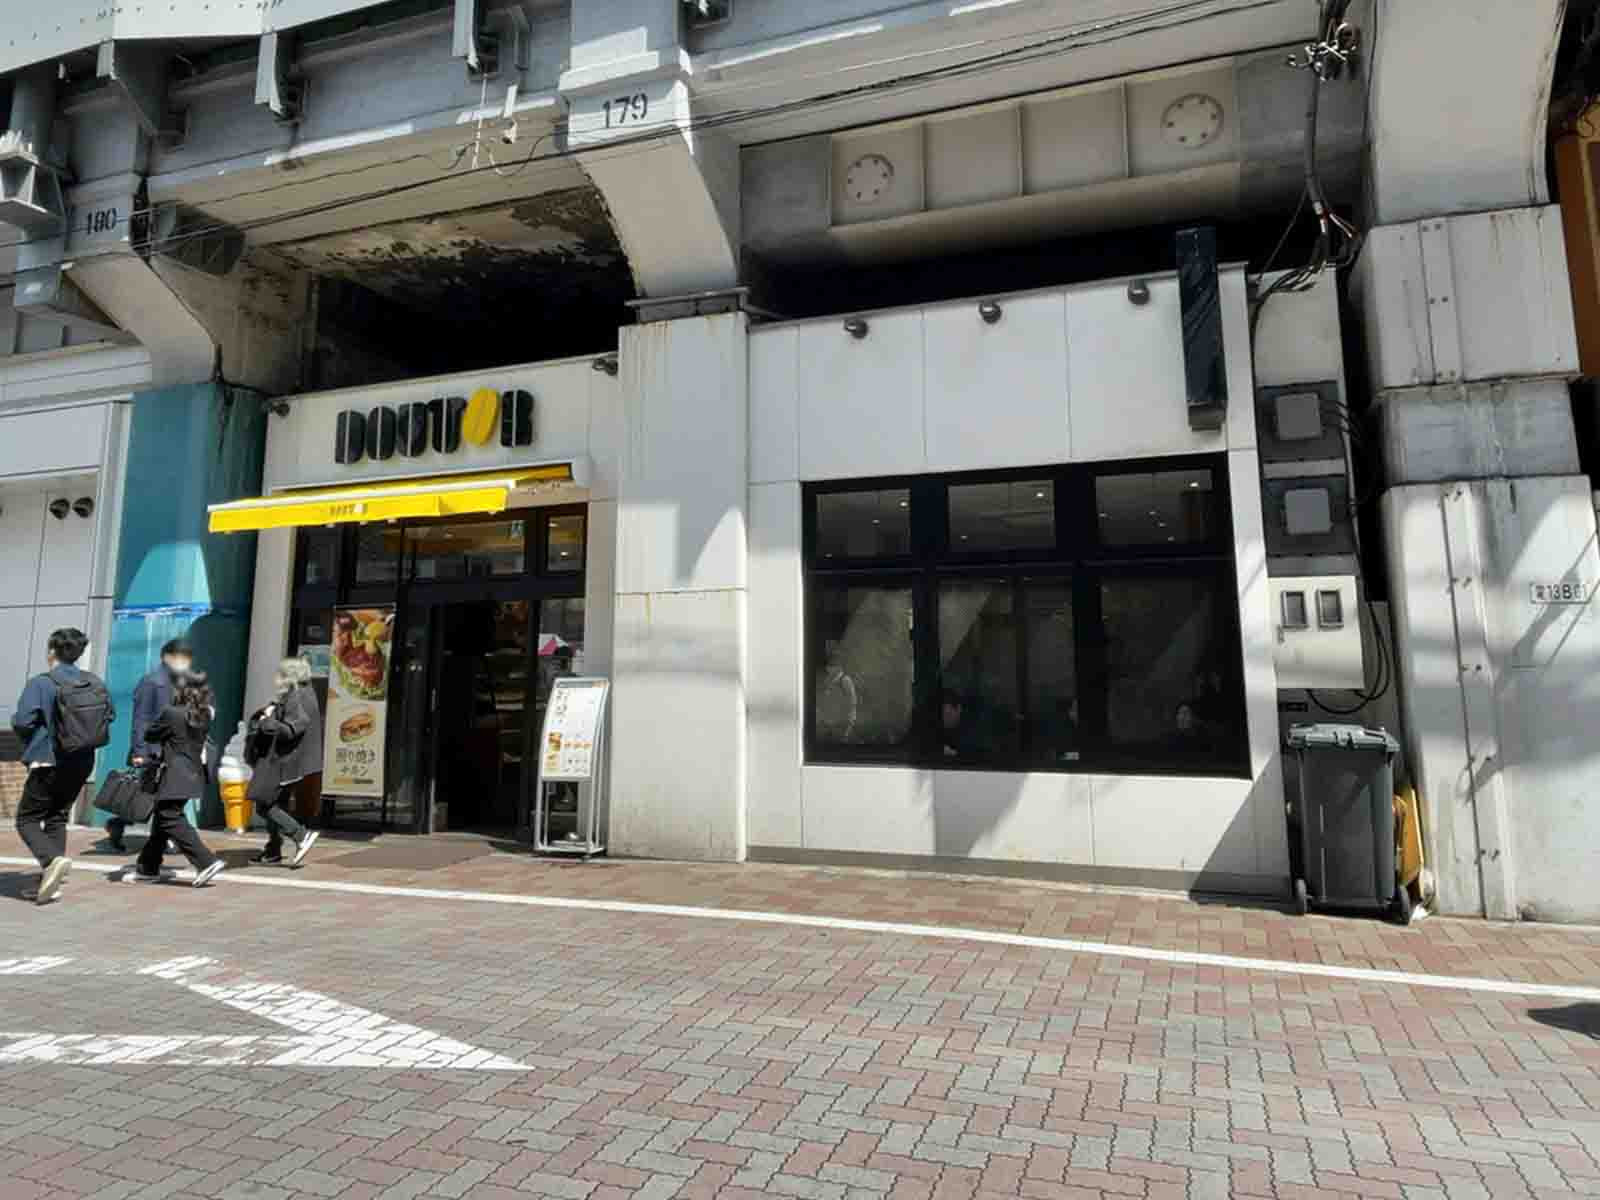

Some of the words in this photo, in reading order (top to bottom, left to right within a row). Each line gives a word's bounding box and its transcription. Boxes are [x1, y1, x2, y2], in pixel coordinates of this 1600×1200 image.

[602, 93, 648, 128] 179
[87, 207, 117, 235] 180
[334, 387, 535, 465] DOUTOR
